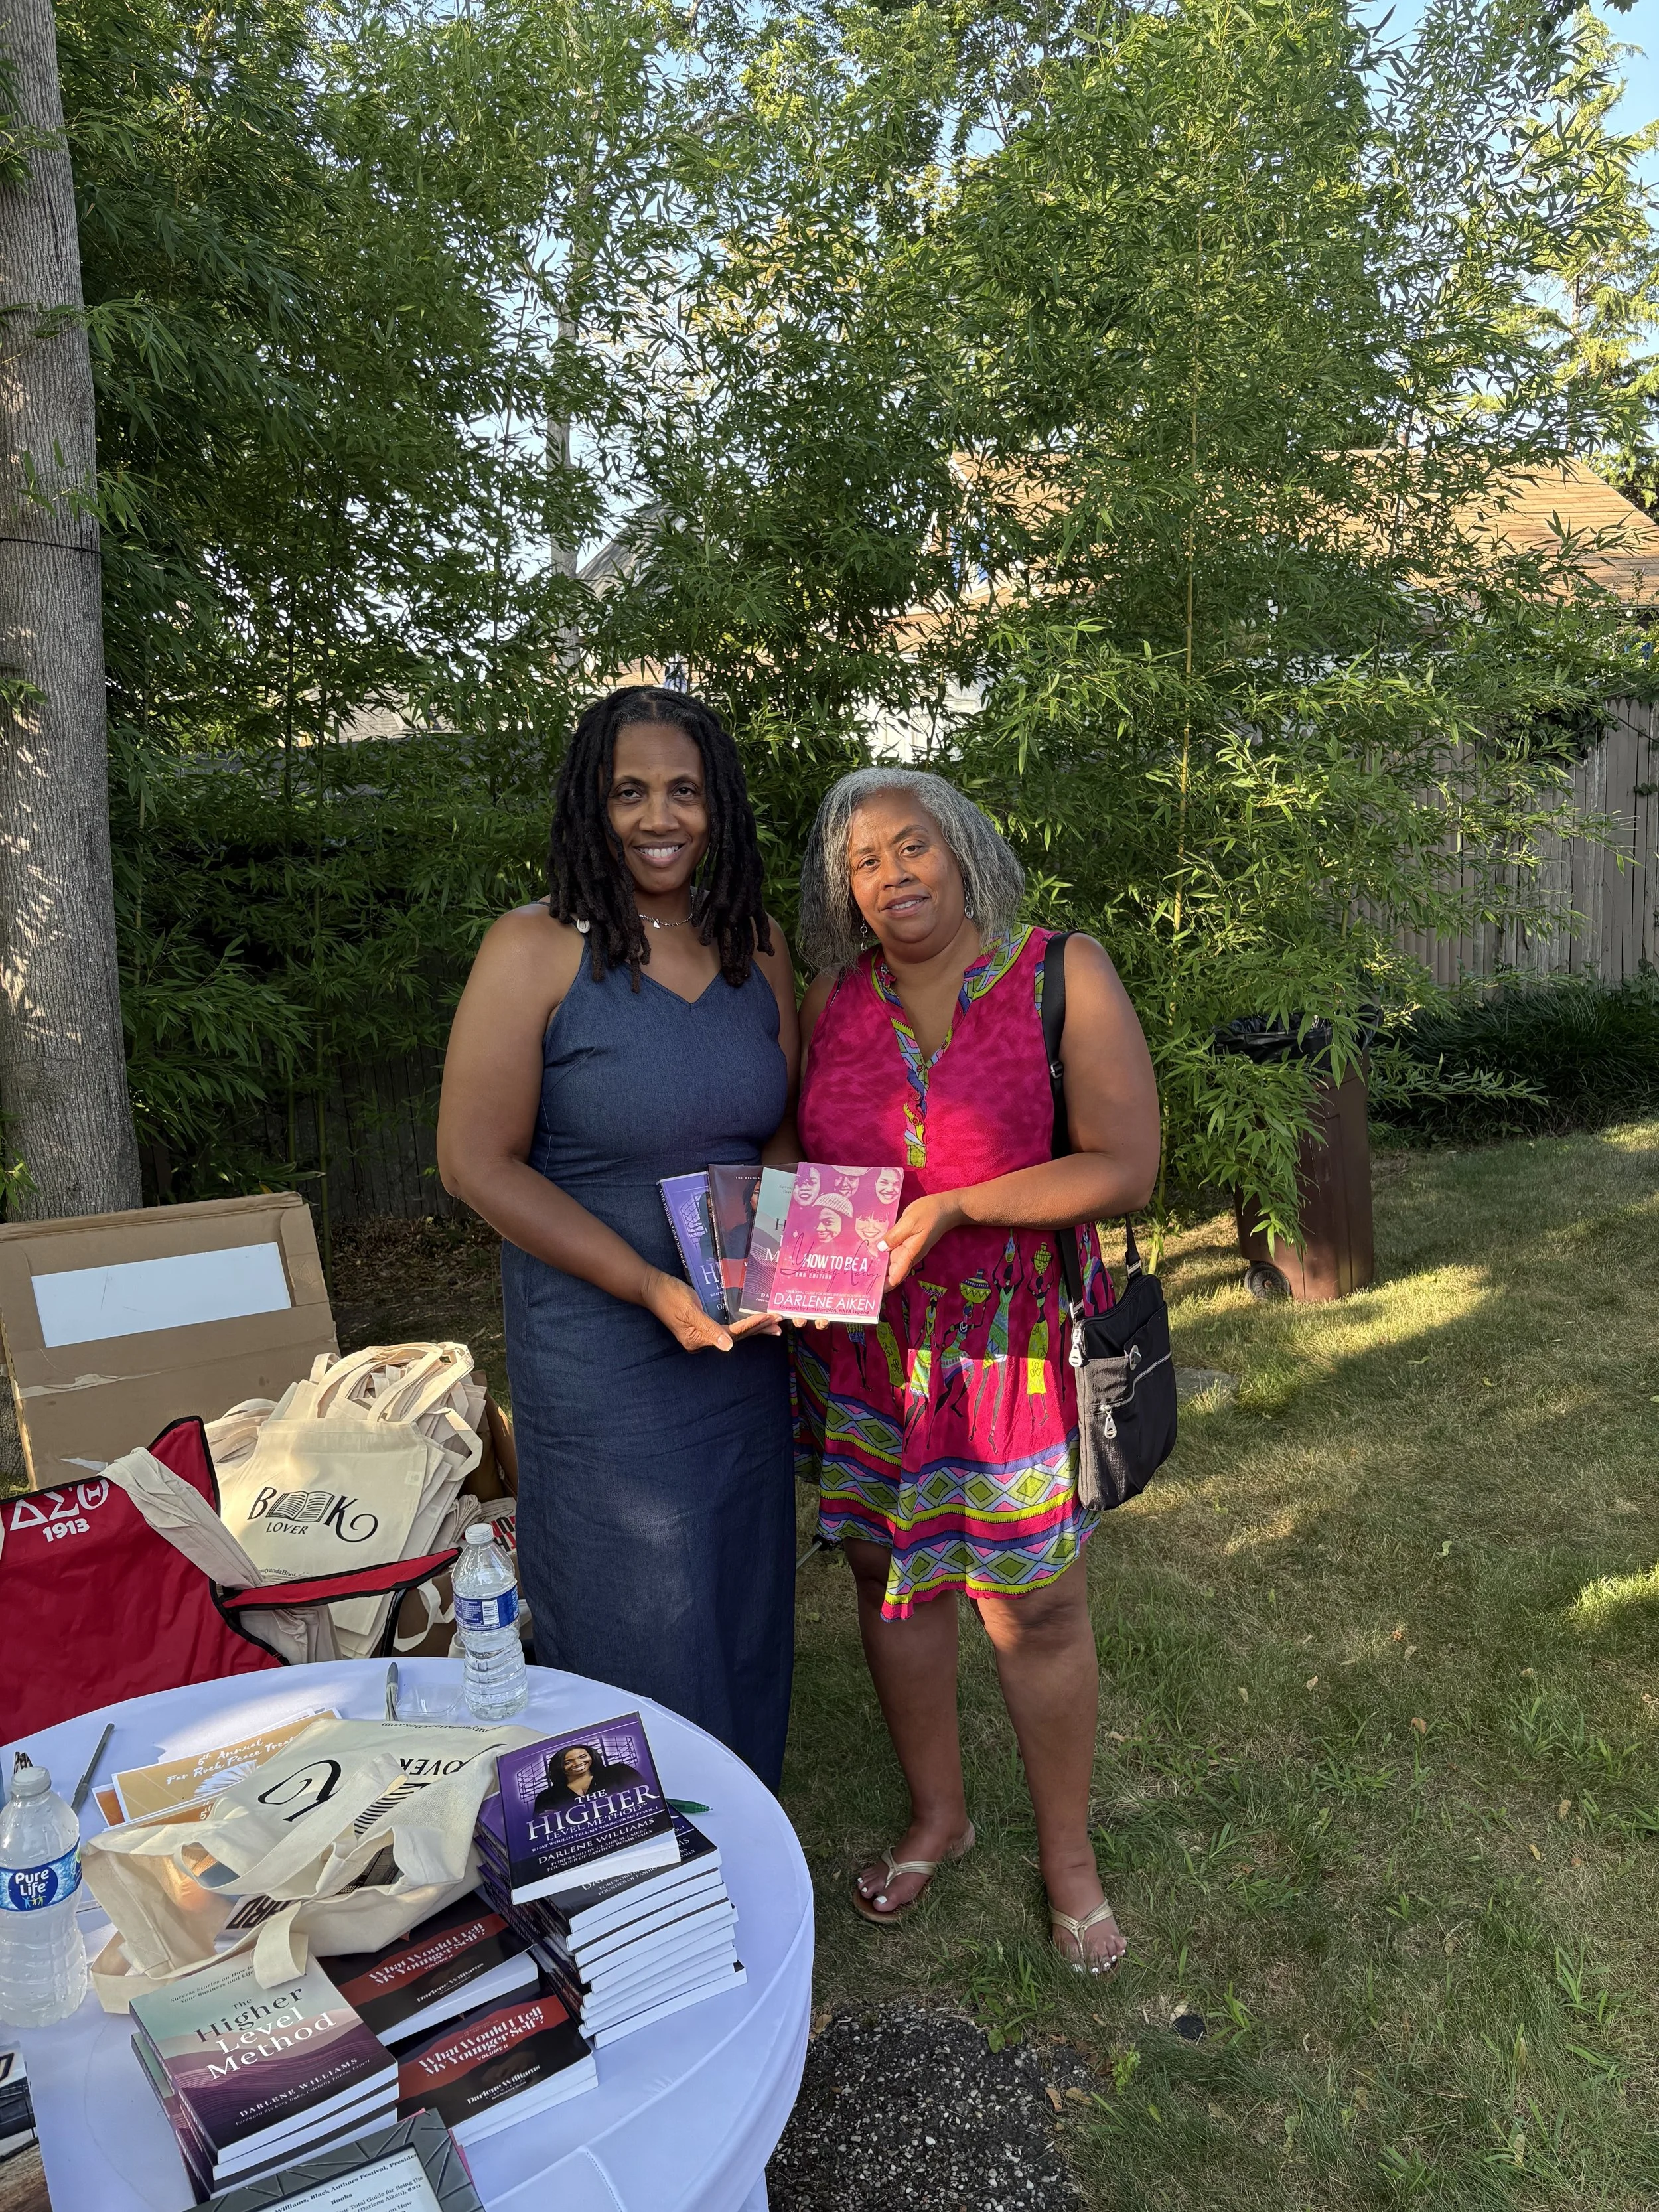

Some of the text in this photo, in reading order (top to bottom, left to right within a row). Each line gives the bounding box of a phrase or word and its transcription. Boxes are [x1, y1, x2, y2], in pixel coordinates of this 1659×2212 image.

[802, 1253, 830, 1270] HOW
[830, 1255, 843, 1270] TO
[859, 1258, 868, 1272] A
[774, 1292, 834, 1308] DARLENE
[835, 1297, 875, 1311] AIKEN
[42, 1518, 90, 1542] 1913
[265, 1522, 309, 1535] LOVER
[217, 1737, 263, 1760] Annual
[166, 1773, 189, 1785] Far
[193, 1761, 225, 1778] Rock
[227, 1751, 263, 1767] Peace
[526, 1785, 660, 1840] HIGHER
[574, 1789, 608, 1804] THE
[531, 1842, 549, 1852] WHAT
[548, 1836, 571, 1847] WOULD
[574, 1830, 589, 1839] TELL
[599, 1818, 626, 1832] YOUNGER
[538, 1840, 593, 1864] DARLENE
[596, 1818, 655, 1843] WILLIAMS
[546, 1824, 585, 1842] LEVEL
[551, 1850, 587, 1866] FOREWORD
[596, 1839, 618, 1850] CLAIRE
[618, 1828, 648, 1841] SULMERS
[547, 1858, 579, 1872] FOUNDER
[587, 1843, 615, 1857] FASHION
[615, 1836, 634, 1847] BOMB
[634, 1829, 653, 1840] DAILY
[15, 1869, 50, 1885] Pure
[20, 1881, 47, 1899] Life
[598, 1881, 627, 1897] FOUNDER
[369, 1960, 407, 1980] What
[407, 1939, 453, 1962] Would
[461, 1923, 485, 1938] Tell
[374, 1927, 486, 1986] My Younger Self?
[424, 1956, 449, 1970] VOLUME
[170, 1990, 196, 2003] Success
[196, 1980, 220, 1992] Stories
[231, 1969, 246, 1979] How
[198, 1982, 226, 1997] Business
[227, 1976, 240, 1984] and
[242, 1970, 255, 1978] Life
[417, 1982, 449, 2002] Darlene
[449, 1962, 484, 1984] Williams
[194, 1988, 303, 2043] Higher
[232, 1998, 253, 2010] The
[205, 2012, 337, 2081] Method
[216, 2006, 306, 2055] Level
[419, 2045, 459, 2068] What
[459, 2022, 508, 2049] Would
[514, 2006, 543, 2024] Tell
[425, 2061, 447, 2077] My
[448, 2033, 510, 2065] Younger
[509, 2014, 545, 2037] Self?
[477, 2046, 504, 2061] VOLUME
[236, 2111, 263, 2126] Foreword
[306, 2080, 331, 2094] Celebrity
[332, 2067, 351, 2081] Fitness
[352, 2059, 370, 2071] Expert
[239, 2089, 295, 2118] DARLENE
[299, 2058, 358, 2091] WILLIAMS
[467, 2084, 502, 2104] Darlene
[502, 2065, 541, 2085] Williams
[274, 2197, 309, 2212] Williams,
[310, 2189, 330, 2200] Black
[331, 2177, 359, 2192] Authors
[359, 2166, 389, 2181] Festival,
[330, 2193, 354, 2205] Books
[349, 2199, 366, 2210] Total
[366, 2192, 386, 2203] Guide
[396, 2180, 413, 2191] Being
[385, 2189, 407, 2202] Aiken),
[397, 2200, 413, 2210] How
